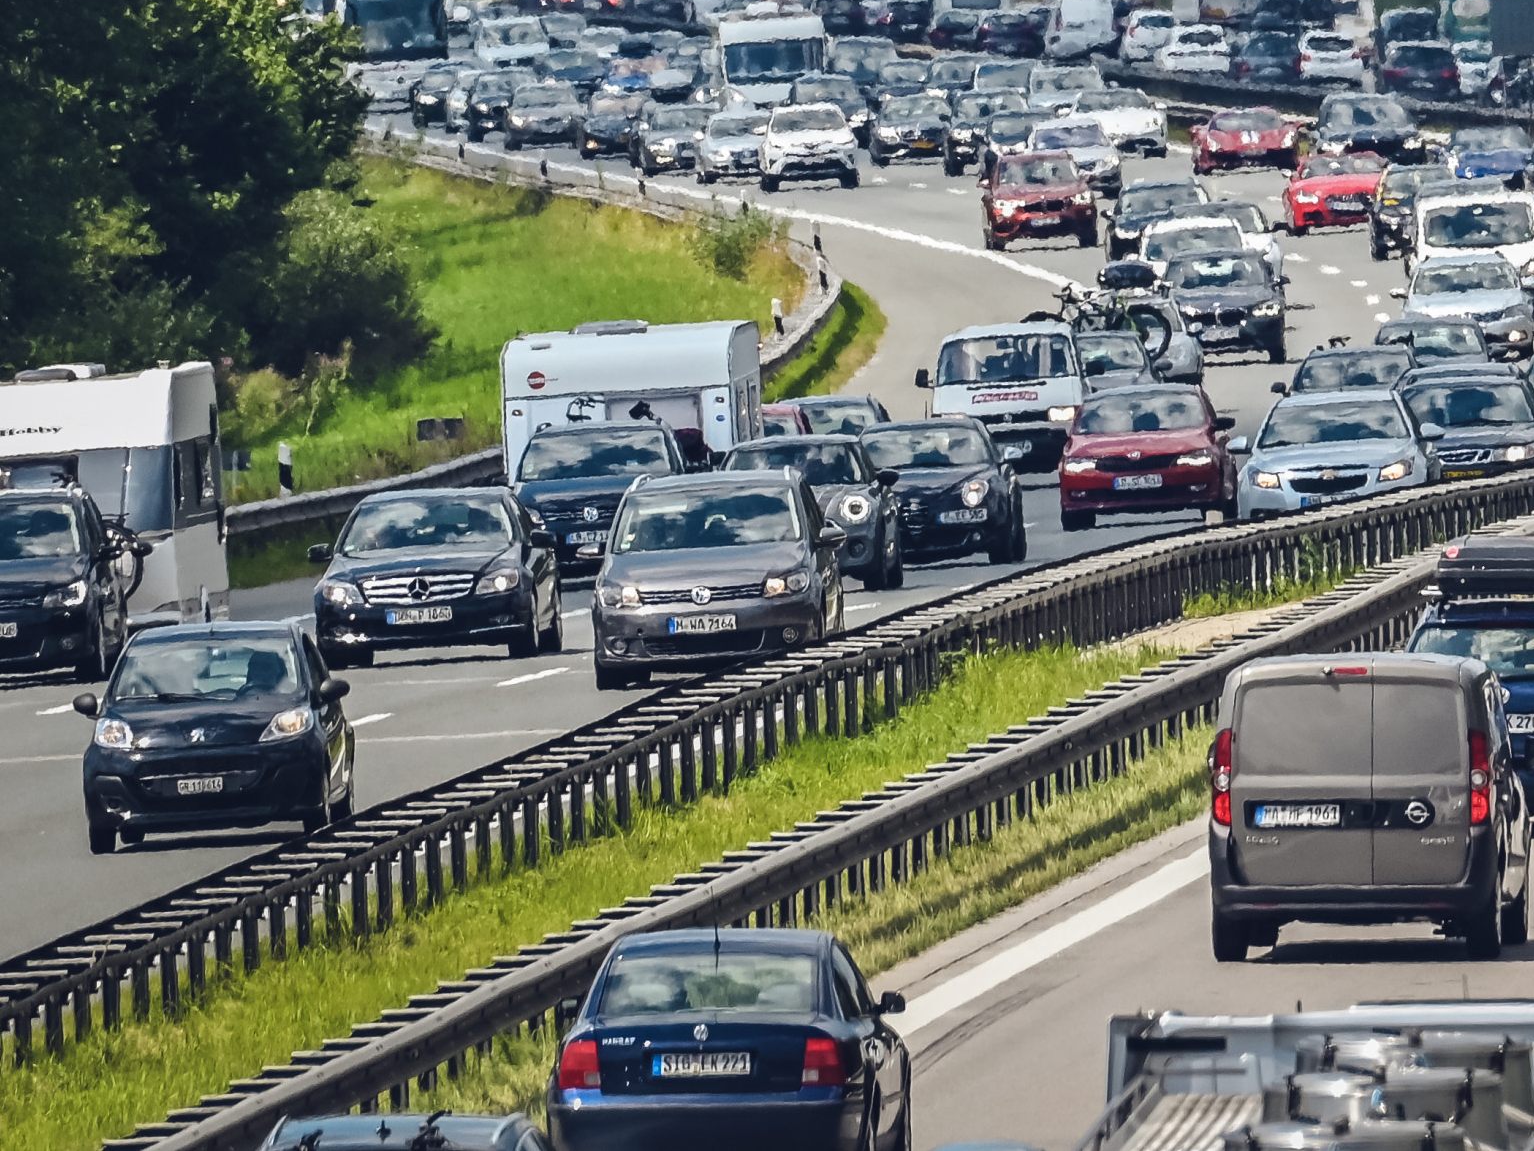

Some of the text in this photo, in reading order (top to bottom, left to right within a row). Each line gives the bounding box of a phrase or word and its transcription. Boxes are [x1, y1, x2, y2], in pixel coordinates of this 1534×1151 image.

[676, 619, 684, 631] M
[708, 617, 734, 630] 7164
[1308, 805, 1338, 820] 1961
[663, 1054, 691, 1072] SIG
